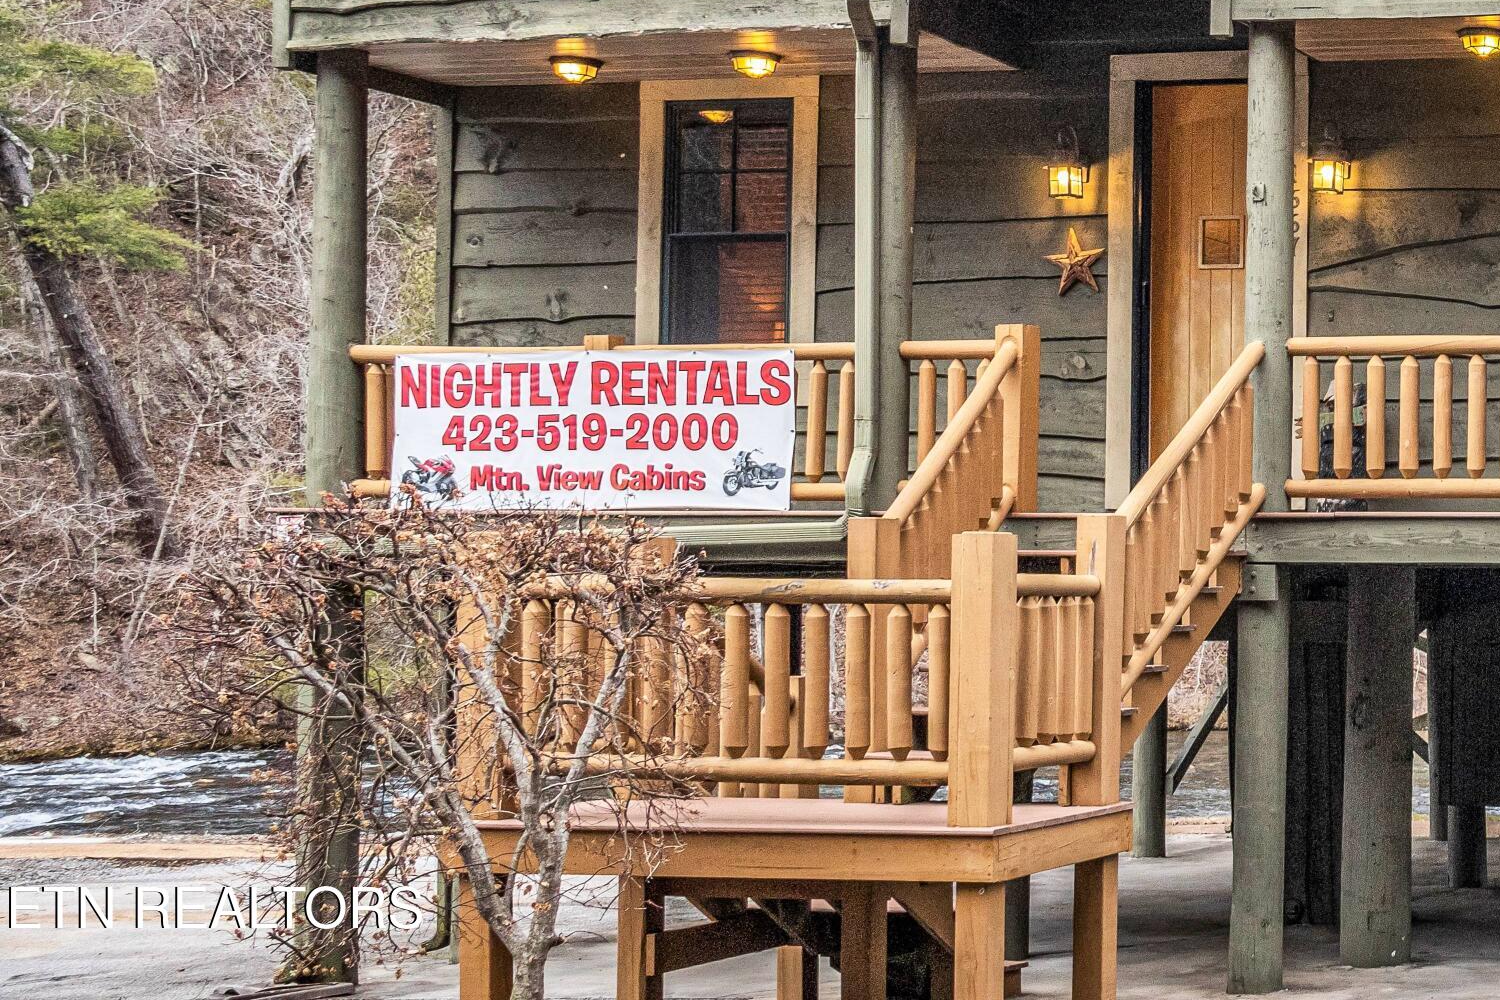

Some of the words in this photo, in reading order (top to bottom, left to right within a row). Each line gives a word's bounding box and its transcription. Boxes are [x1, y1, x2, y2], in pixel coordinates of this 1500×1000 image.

[400, 361, 579, 409] NIGHTLY
[590, 359, 791, 407] RENTALS
[442, 412, 739, 452] 423-519-2000
[469, 464, 530, 492] Mtn.
[536, 462, 603, 492] View
[609, 462, 706, 492] Cabins
